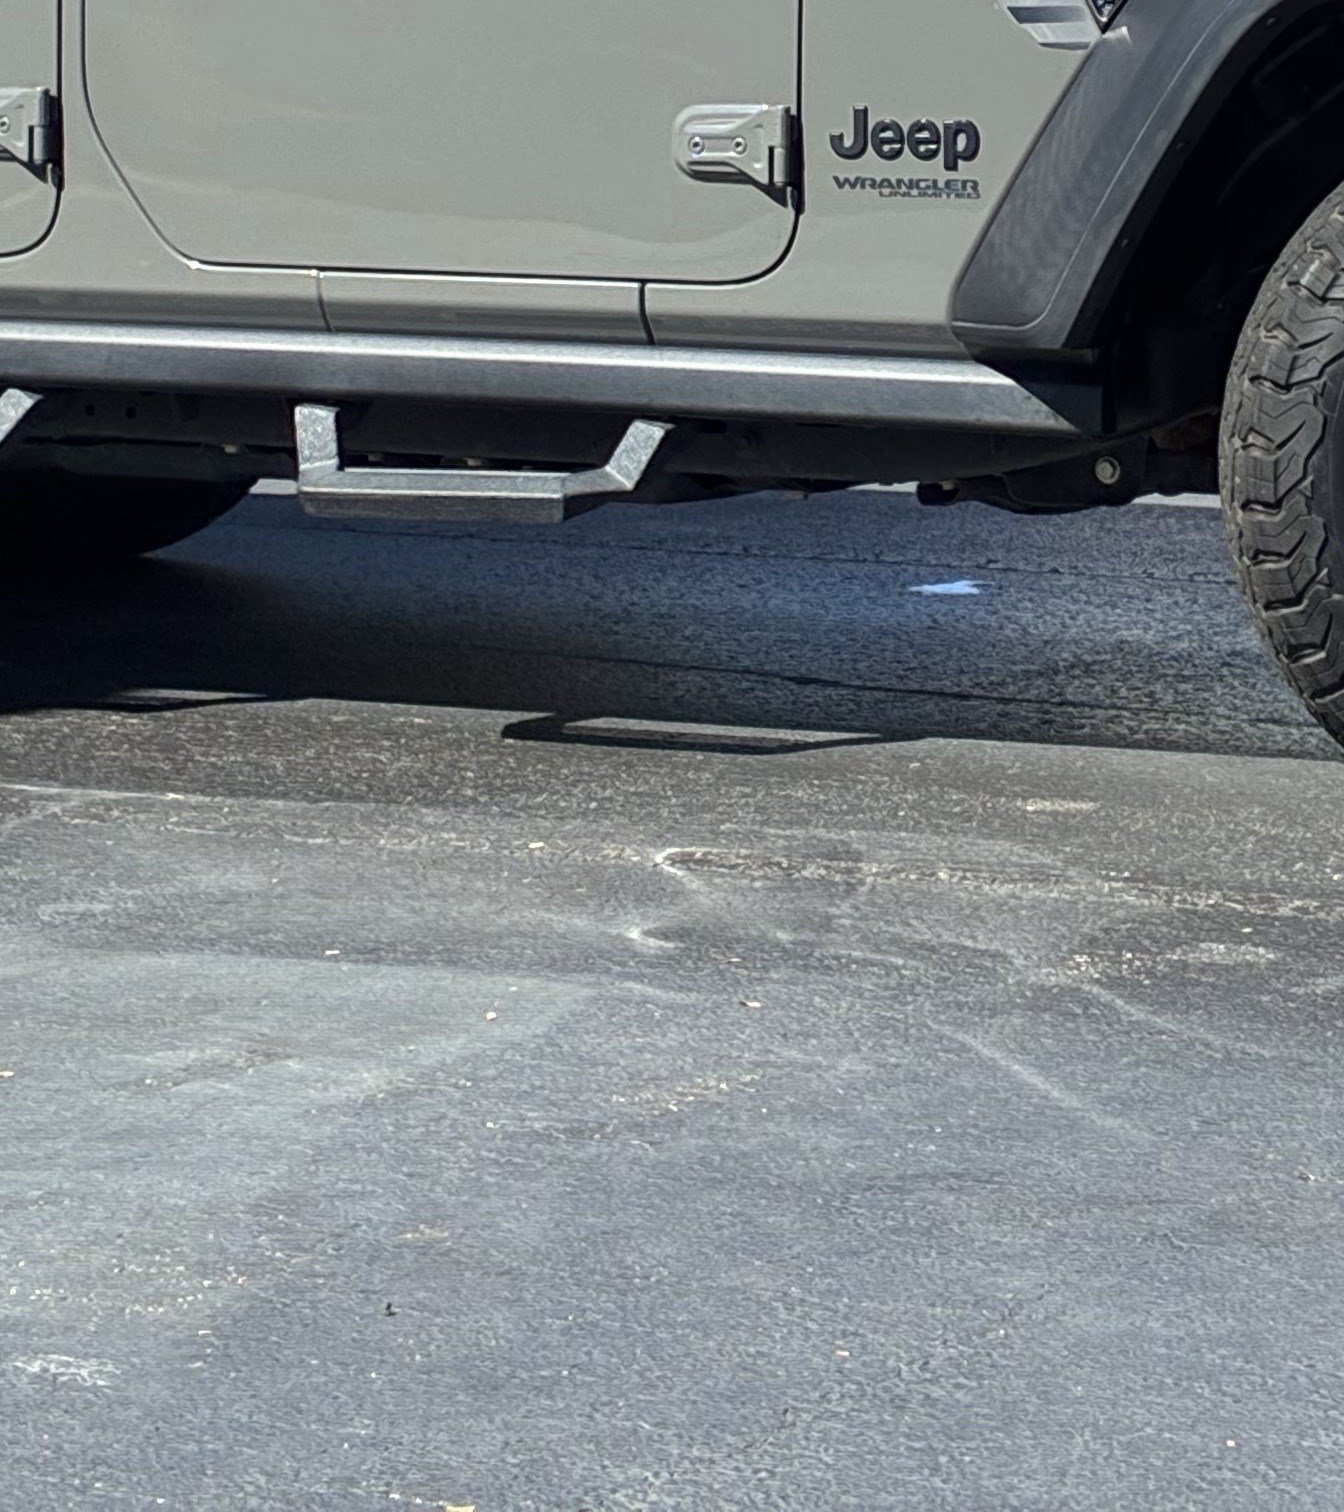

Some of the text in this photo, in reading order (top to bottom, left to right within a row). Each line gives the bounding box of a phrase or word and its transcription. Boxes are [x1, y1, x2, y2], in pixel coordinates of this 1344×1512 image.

[829, 105, 981, 172] Jeep
[832, 175, 979, 192] WRANGLER
[879, 190, 981, 200] UNLIMITED
